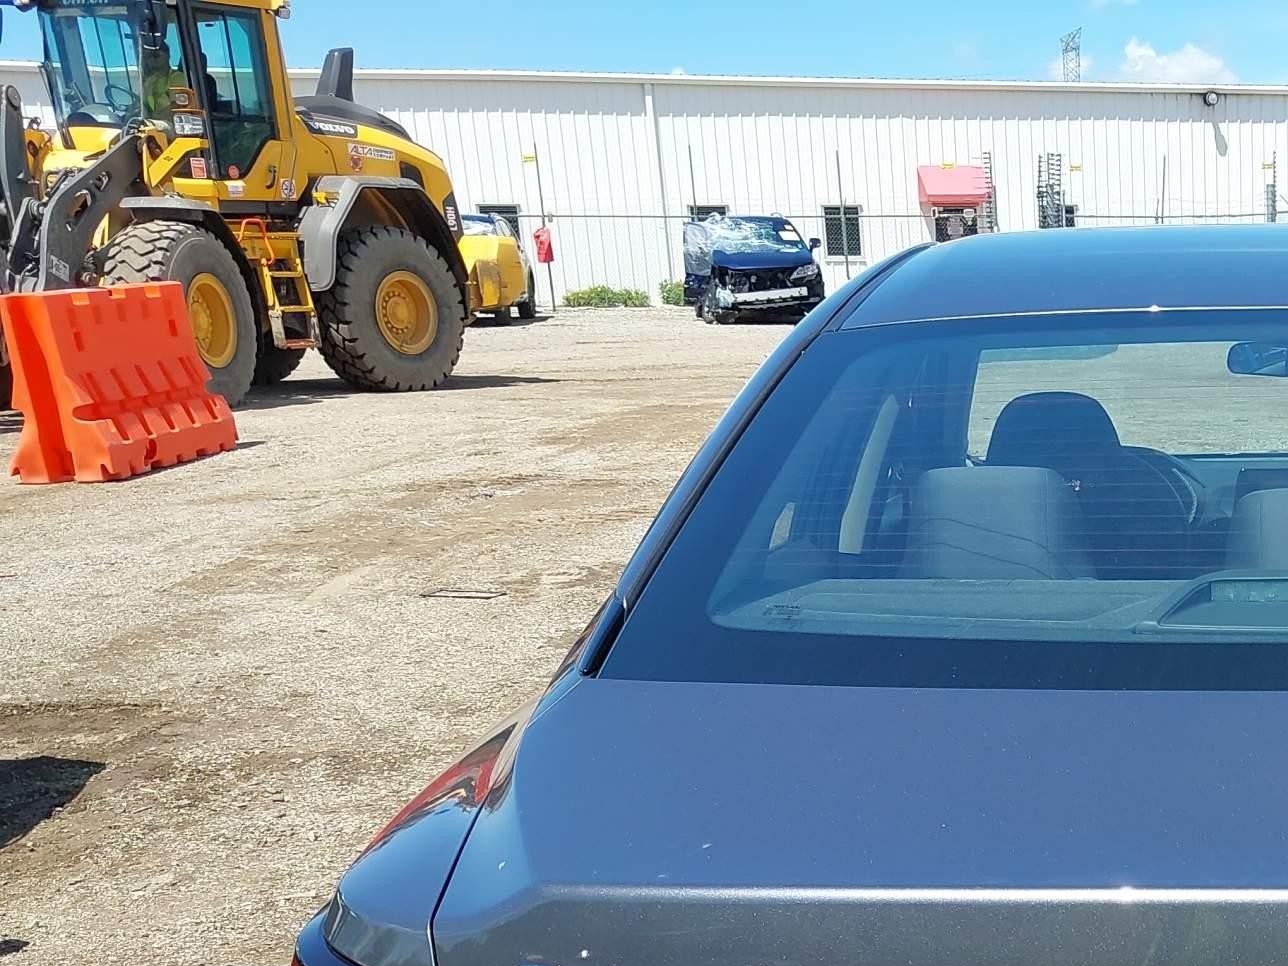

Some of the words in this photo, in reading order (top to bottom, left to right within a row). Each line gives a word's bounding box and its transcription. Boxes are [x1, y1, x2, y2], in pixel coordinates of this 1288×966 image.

[309, 120, 355, 134] VOLVO
[350, 145, 373, 156] ALTA
[445, 206, 458, 231] L90H
